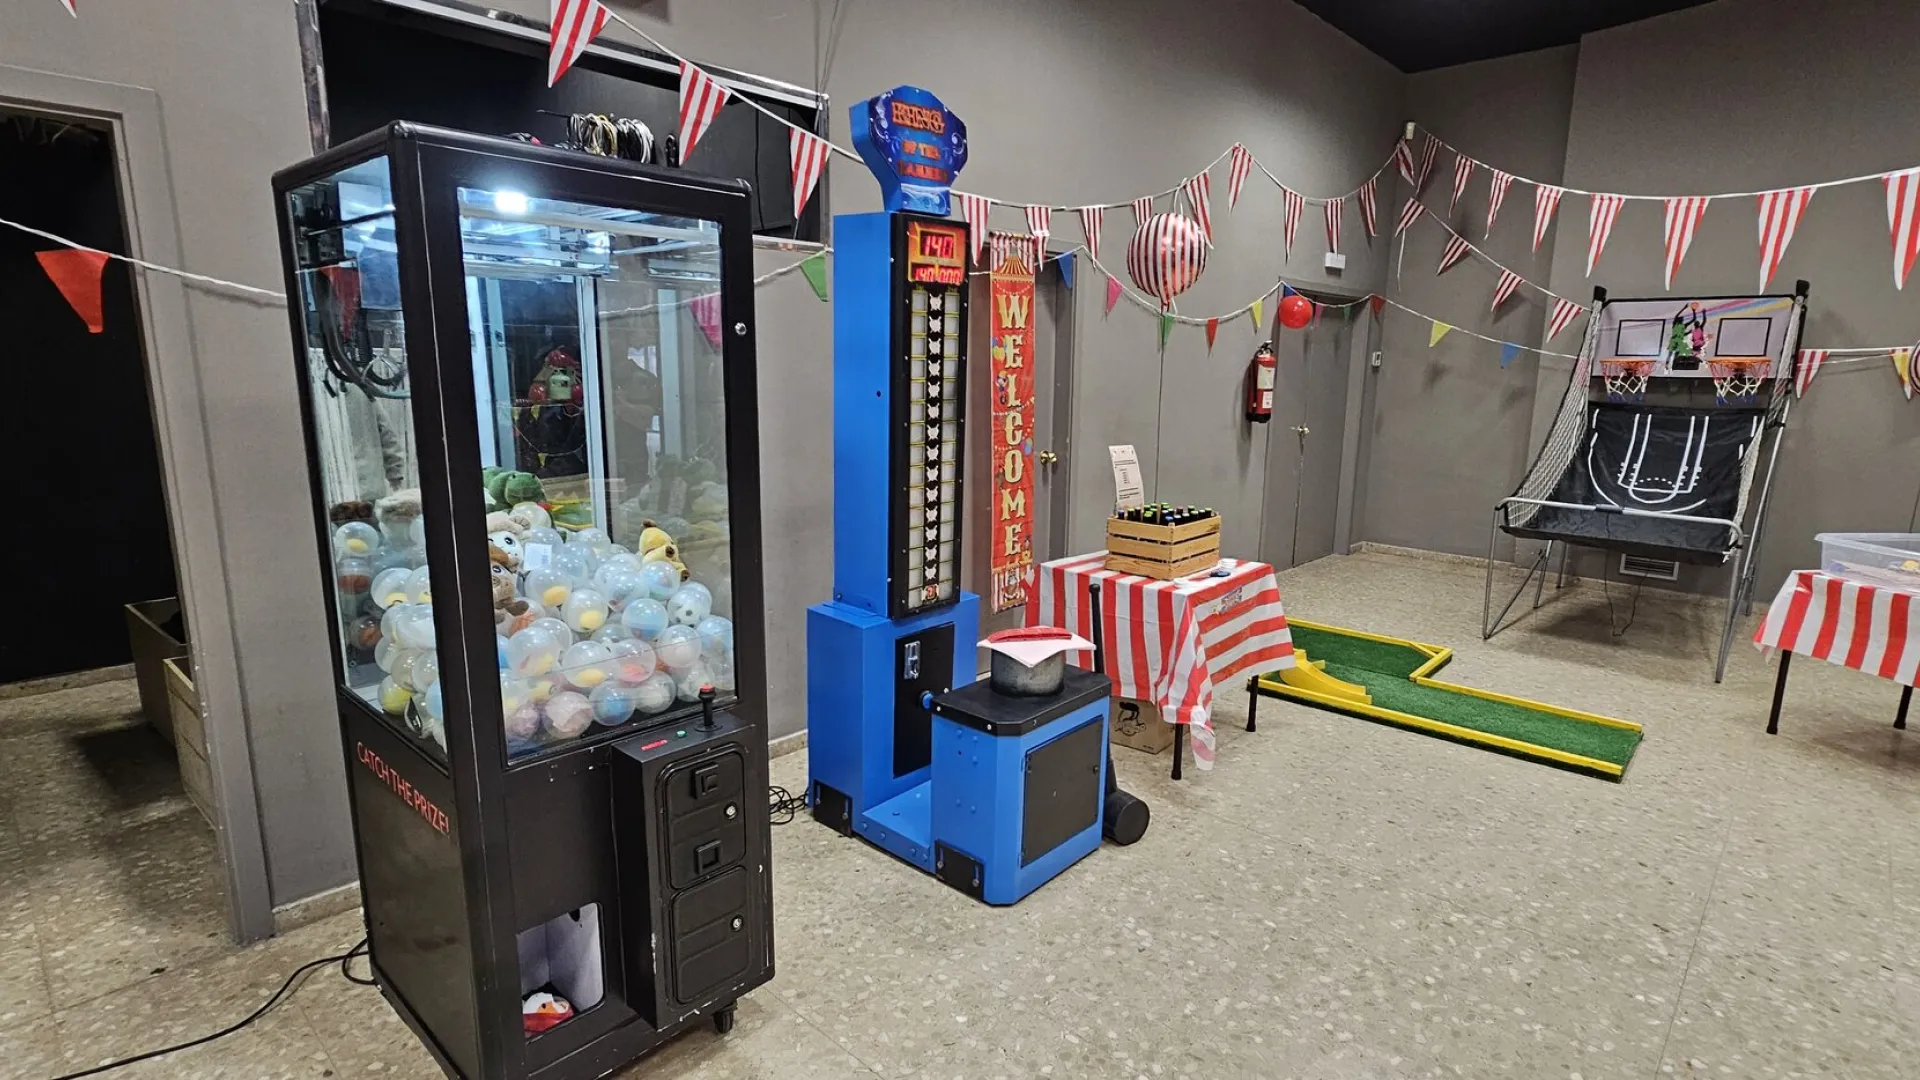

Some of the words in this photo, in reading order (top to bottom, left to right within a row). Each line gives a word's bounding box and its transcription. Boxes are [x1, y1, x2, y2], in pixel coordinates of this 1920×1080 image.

[891, 101, 945, 135] KING
[925, 235, 953, 258] 140
[997, 294, 1031, 556] WELCOME
[357, 741, 390, 785] CATCH
[390, 768, 413, 806] THE
[413, 789, 450, 839] PRIZE!
